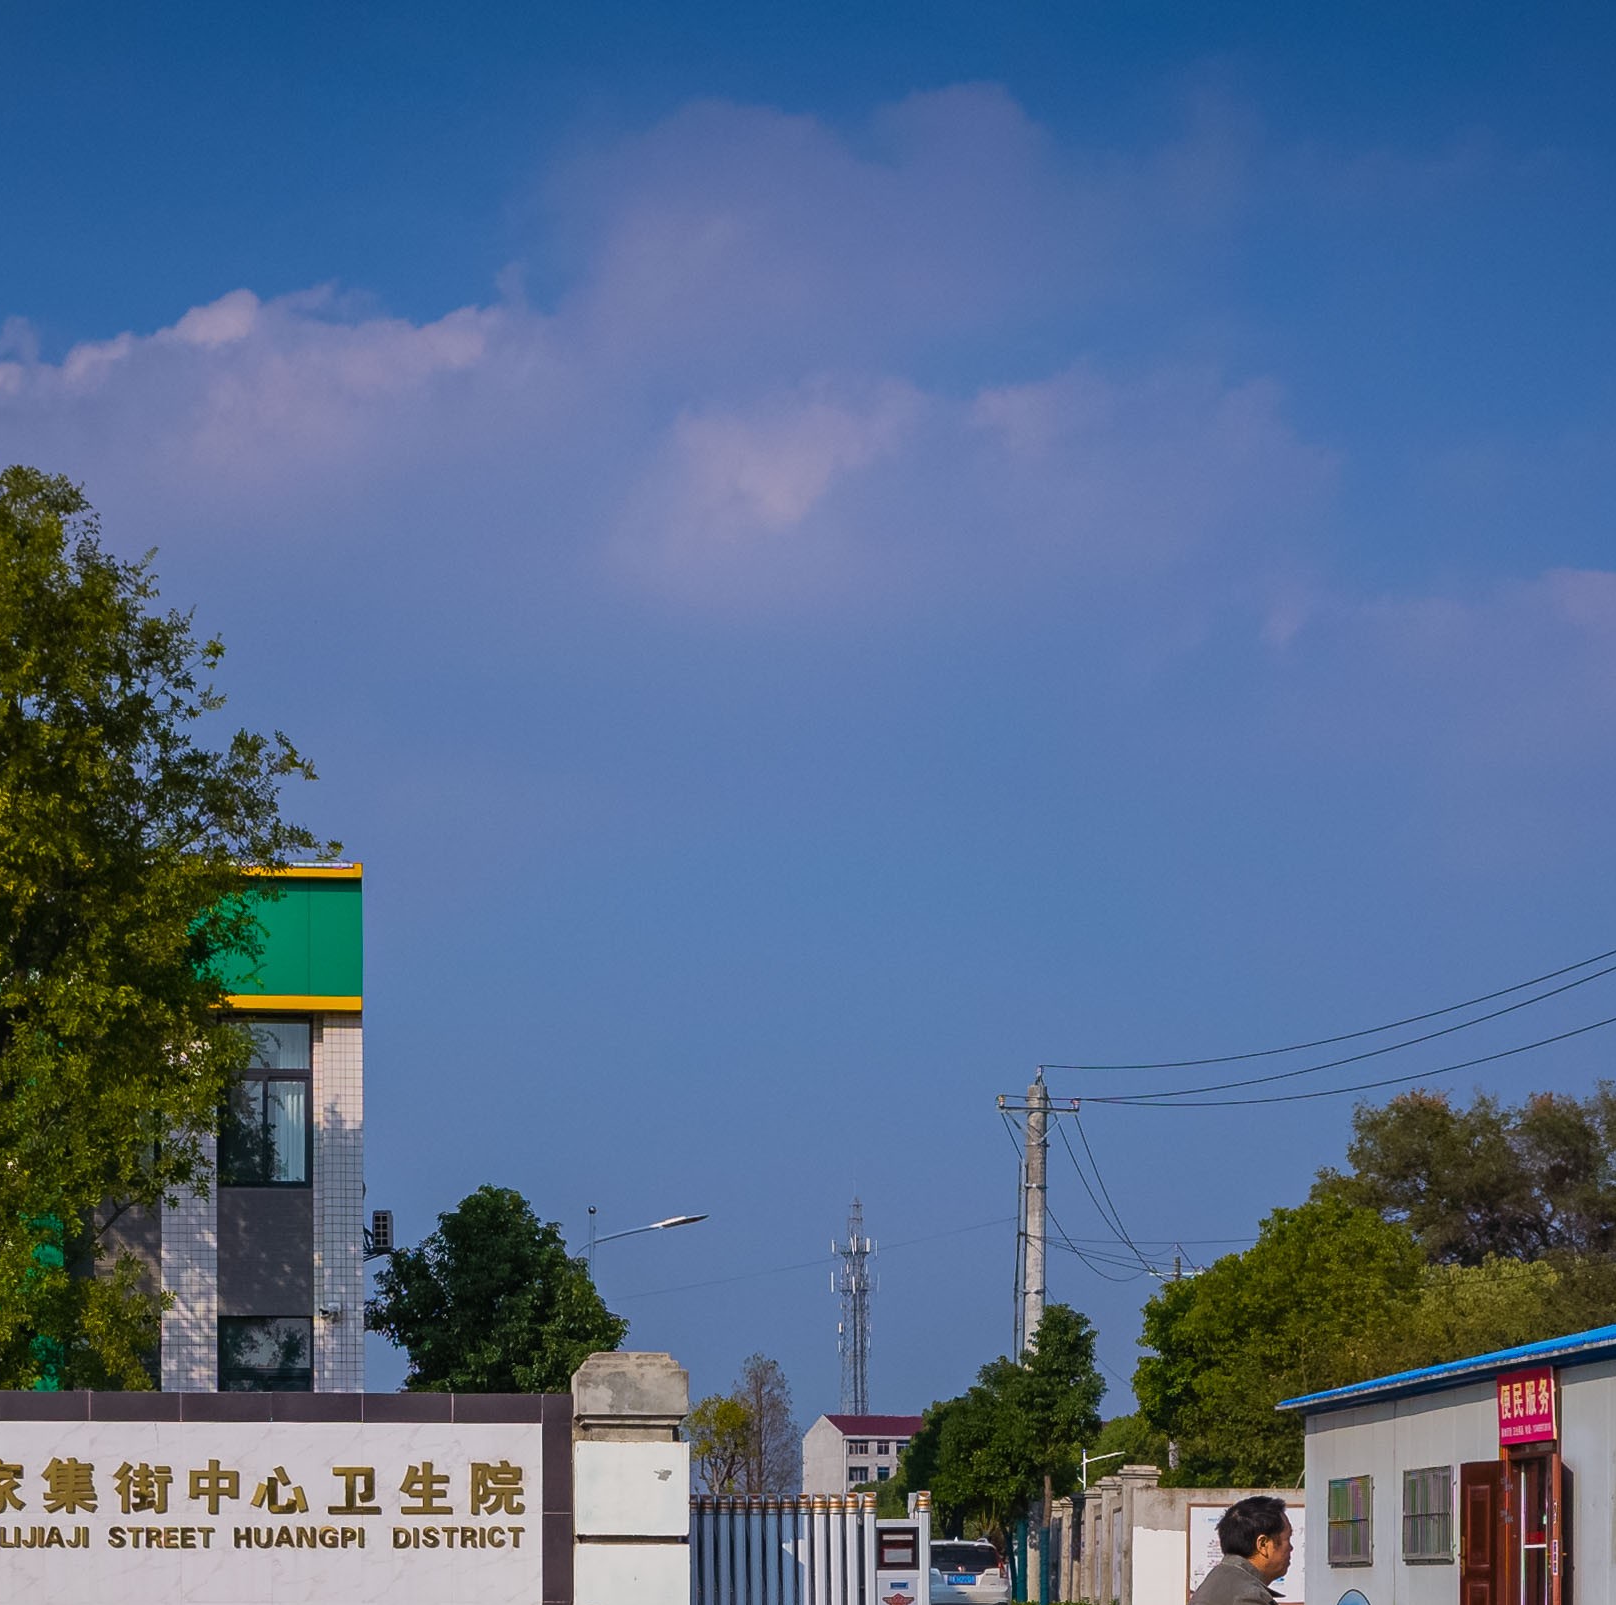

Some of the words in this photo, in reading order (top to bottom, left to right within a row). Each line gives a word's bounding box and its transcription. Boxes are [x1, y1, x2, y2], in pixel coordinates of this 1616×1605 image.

[1500, 1377, 1550, 1420] 便民服务
[0, 1525, 90, 1550] LIJIAJI
[107, 1525, 216, 1550] STREET
[233, 1525, 366, 1550] HUANGPI
[392, 1525, 526, 1550] DISTRICT
